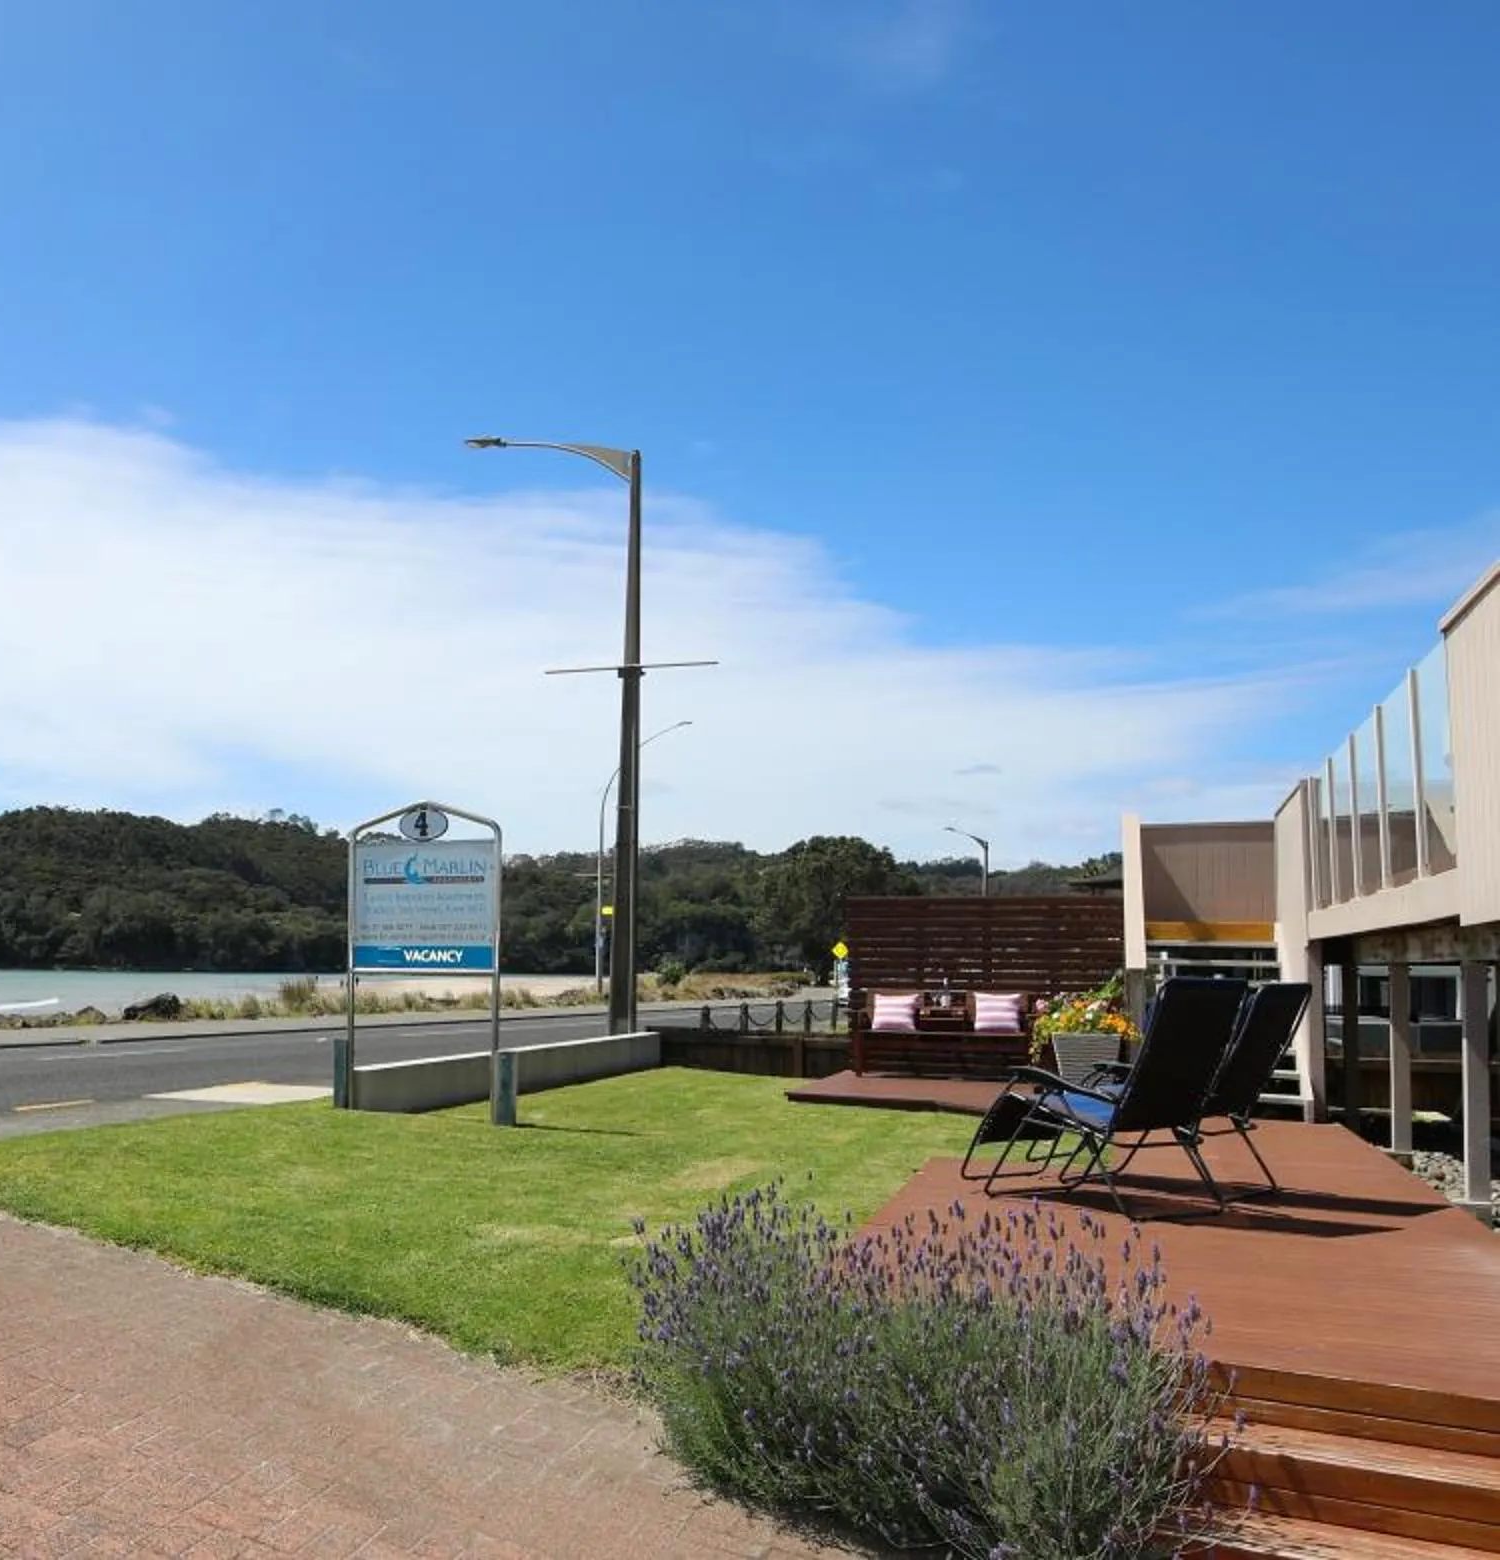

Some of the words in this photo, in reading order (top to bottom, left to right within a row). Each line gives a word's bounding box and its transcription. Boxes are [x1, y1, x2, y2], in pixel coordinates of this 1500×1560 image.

[414, 811, 429, 837] 4
[363, 858, 401, 875] BLUE
[422, 858, 487, 875] MARLIN
[403, 949, 463, 963] VACANCY
